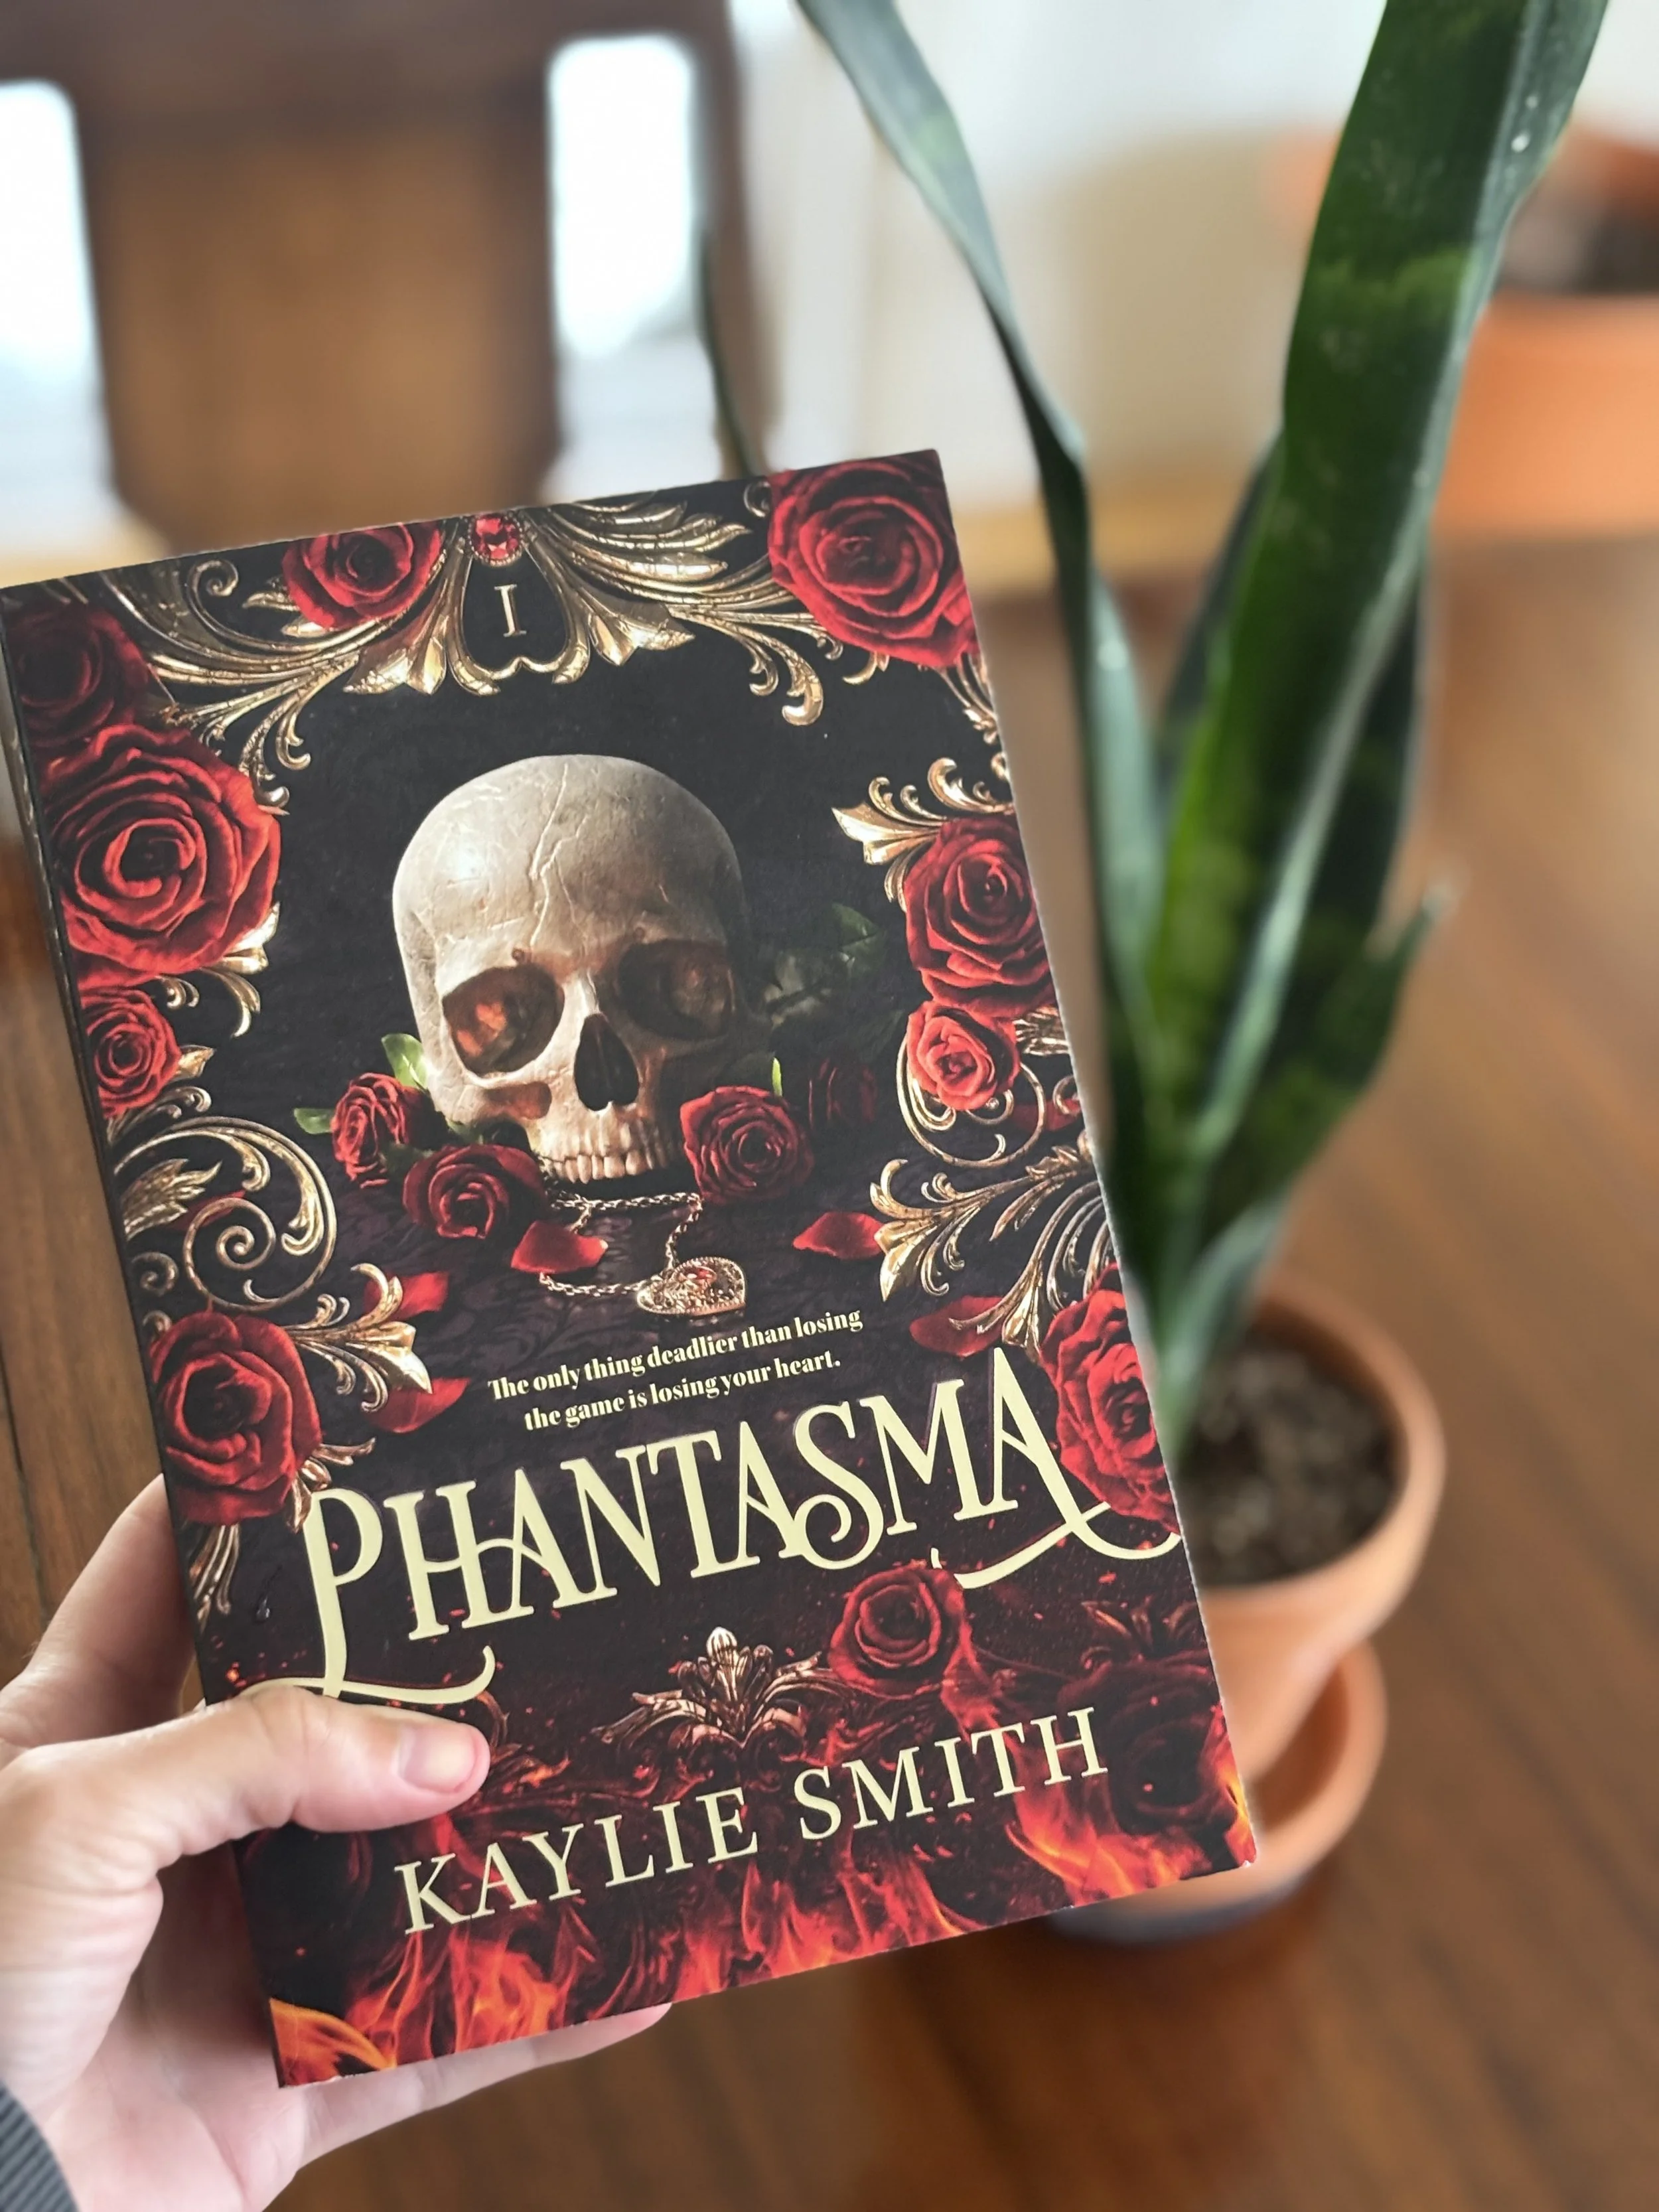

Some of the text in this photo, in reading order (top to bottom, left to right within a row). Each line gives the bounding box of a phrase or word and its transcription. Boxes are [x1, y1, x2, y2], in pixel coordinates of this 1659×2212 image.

[494, 583, 527, 637] I
[488, 1310, 863, 1400] The only thing deadlier than losing
[524, 1350, 841, 1430] the game is losing your heart.
[240, 1347, 1181, 1704] PHANTASMA
[394, 1706, 1109, 1935] KAYLIE SMITH
